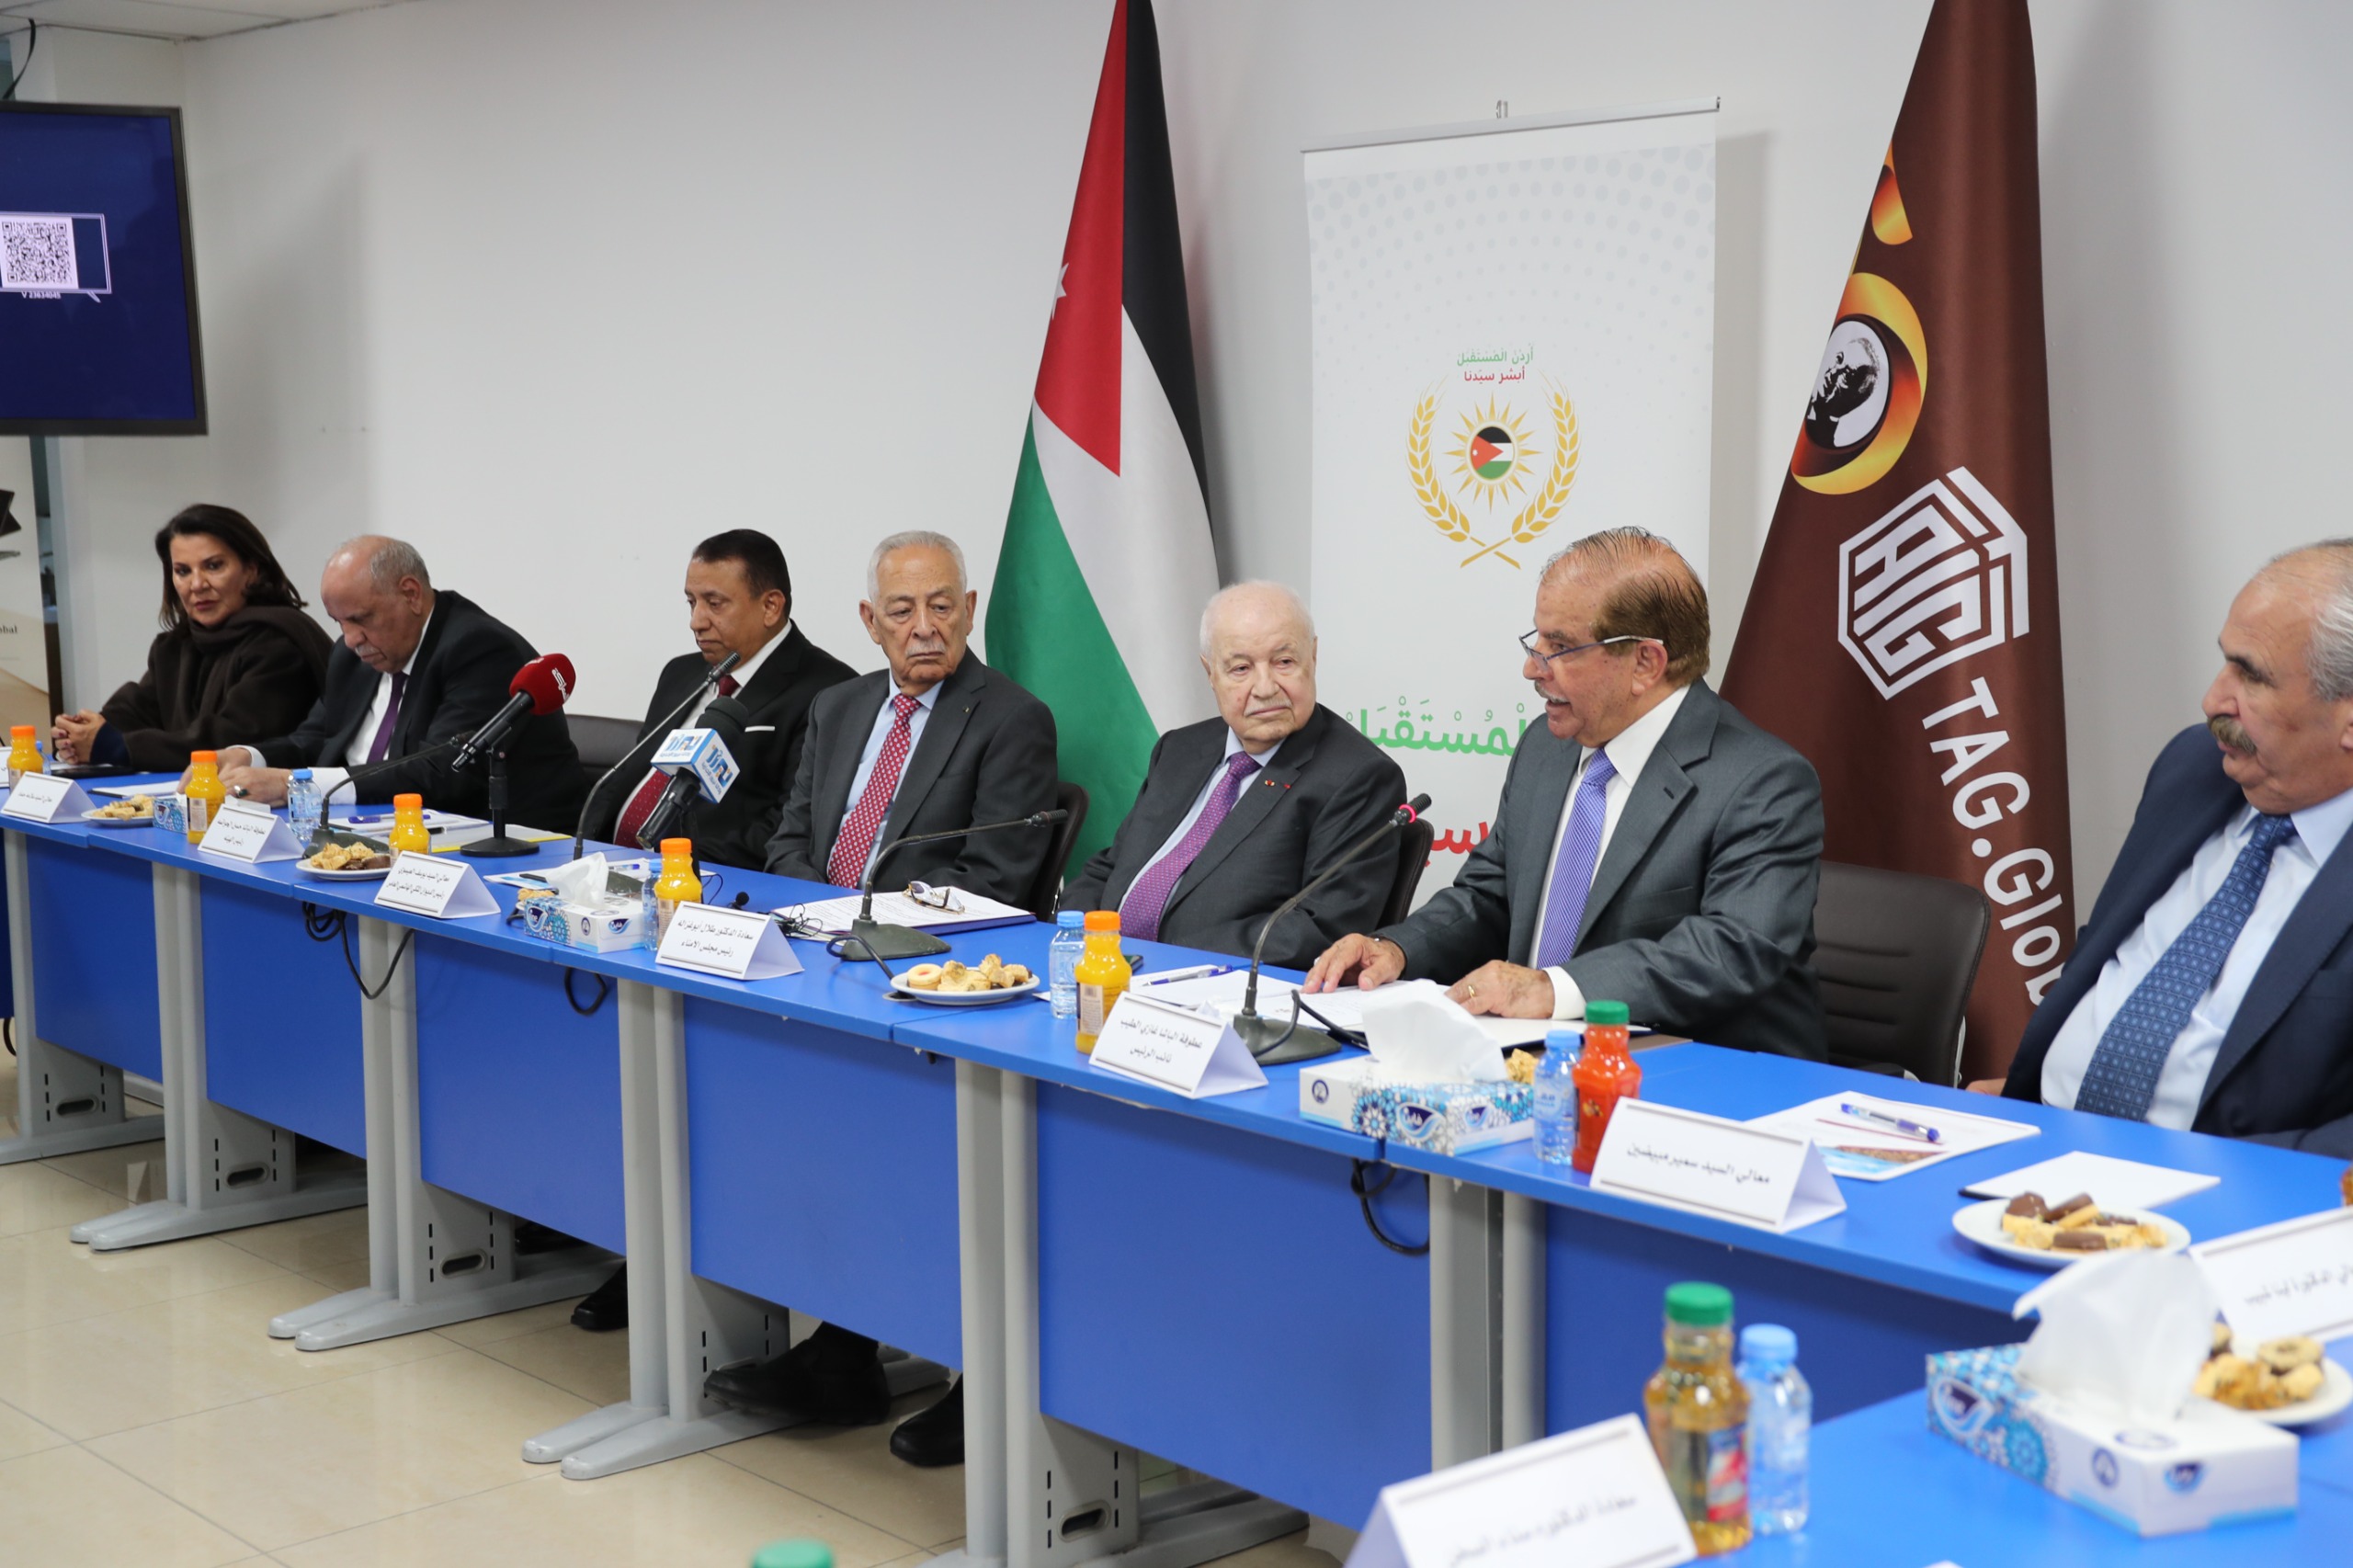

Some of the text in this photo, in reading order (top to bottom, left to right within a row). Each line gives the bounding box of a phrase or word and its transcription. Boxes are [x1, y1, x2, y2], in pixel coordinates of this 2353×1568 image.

[1498, 365, 1526, 384] أبشر
[0, 625, 18, 634] bal
[715, 926, 736, 937] الدكتور
[737, 929, 754, 939] سعادة
[699, 942, 718, 953] مجلس
[717, 947, 734, 958] رئيس
[1159, 1027, 1178, 1043] الباشا
[1179, 1032, 1202, 1049] عطوفة
[1130, 1045, 1172, 1063] نائب الرئيس
[1700, 1161, 1735, 1175] السيد
[1735, 1168, 1770, 1184] معالي
